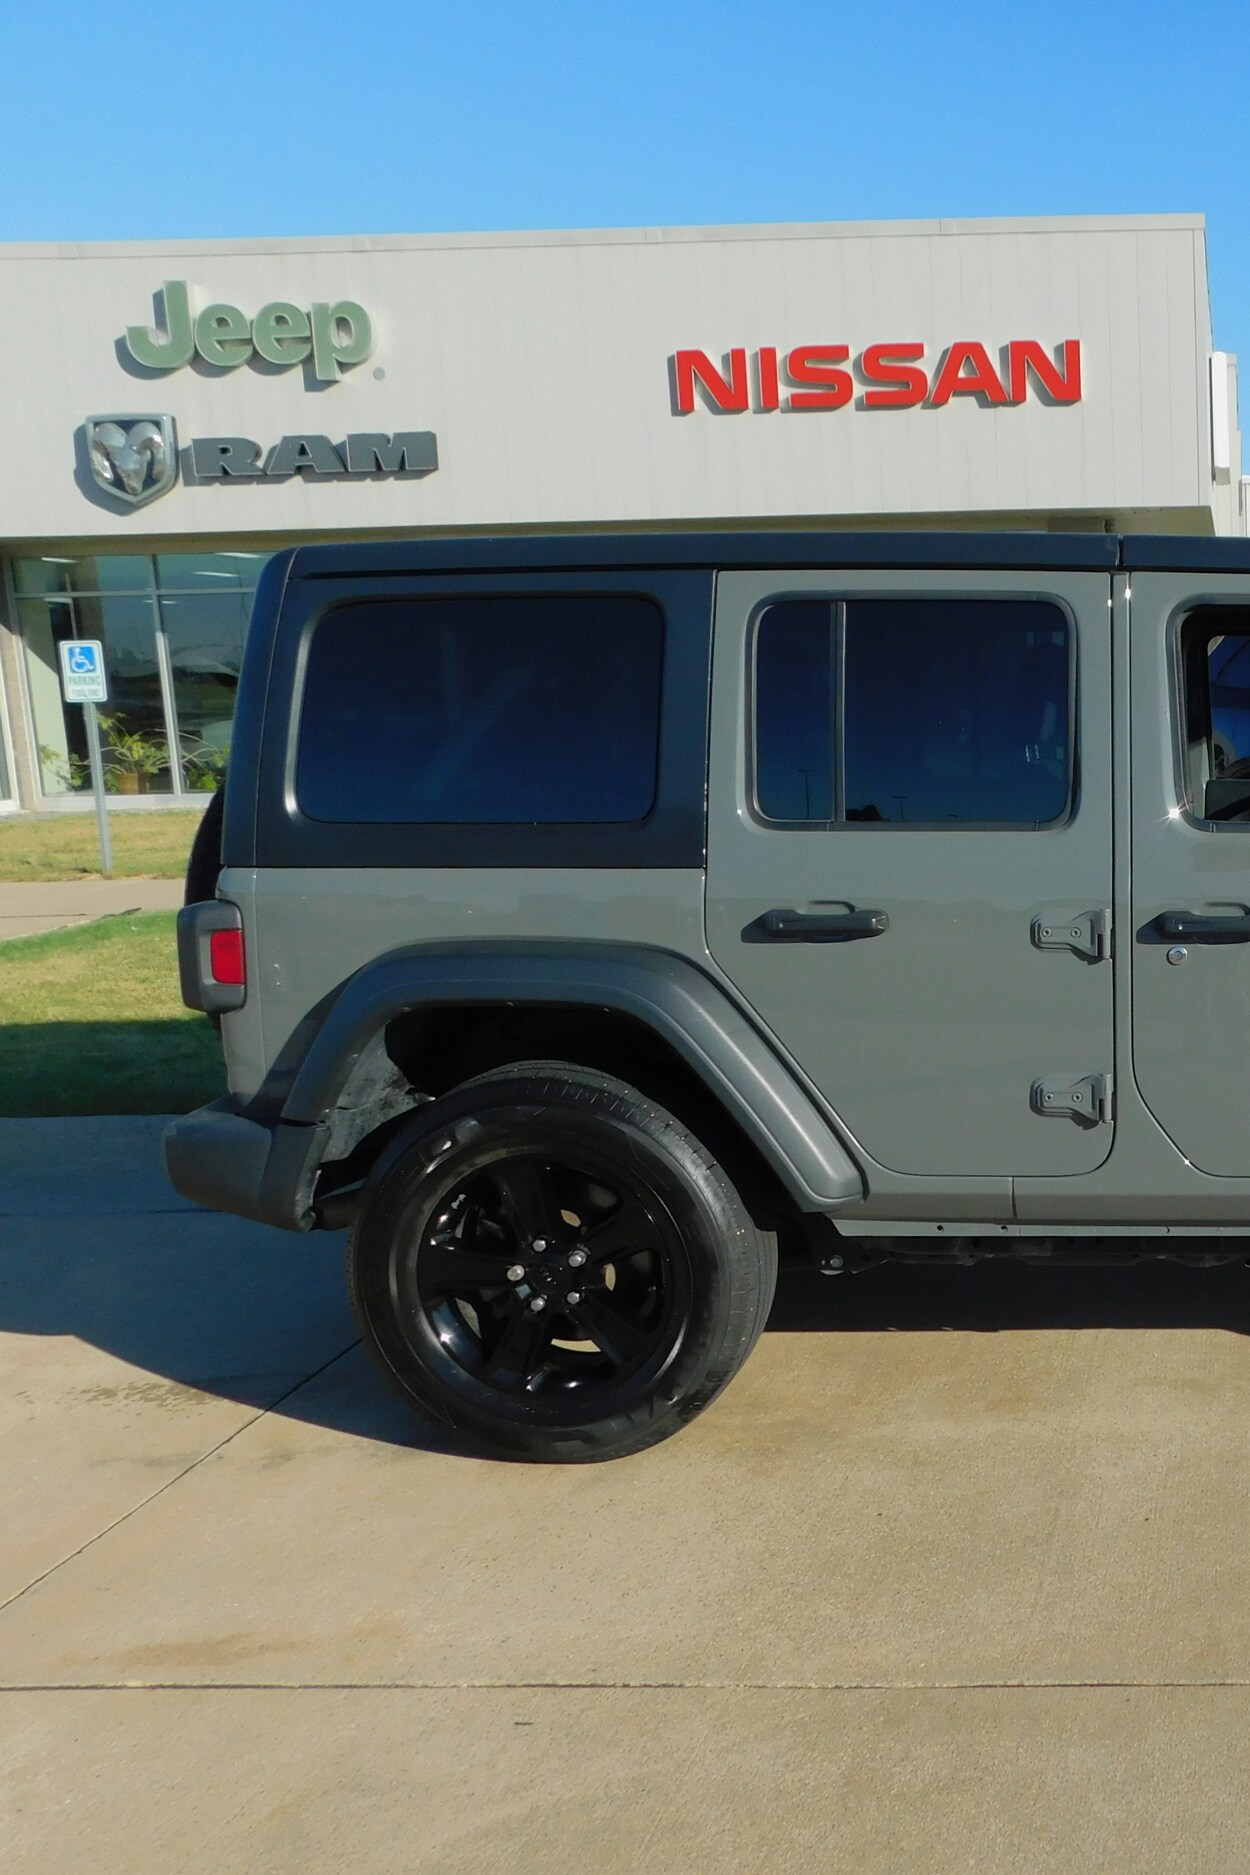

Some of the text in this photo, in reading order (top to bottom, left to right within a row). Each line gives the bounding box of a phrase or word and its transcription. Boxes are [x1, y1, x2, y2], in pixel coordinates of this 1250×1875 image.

[125, 279, 374, 382] Jeep
[675, 339, 1082, 412] NISSAN
[192, 430, 439, 478] RAM
[68, 675, 101, 686] PARKING
